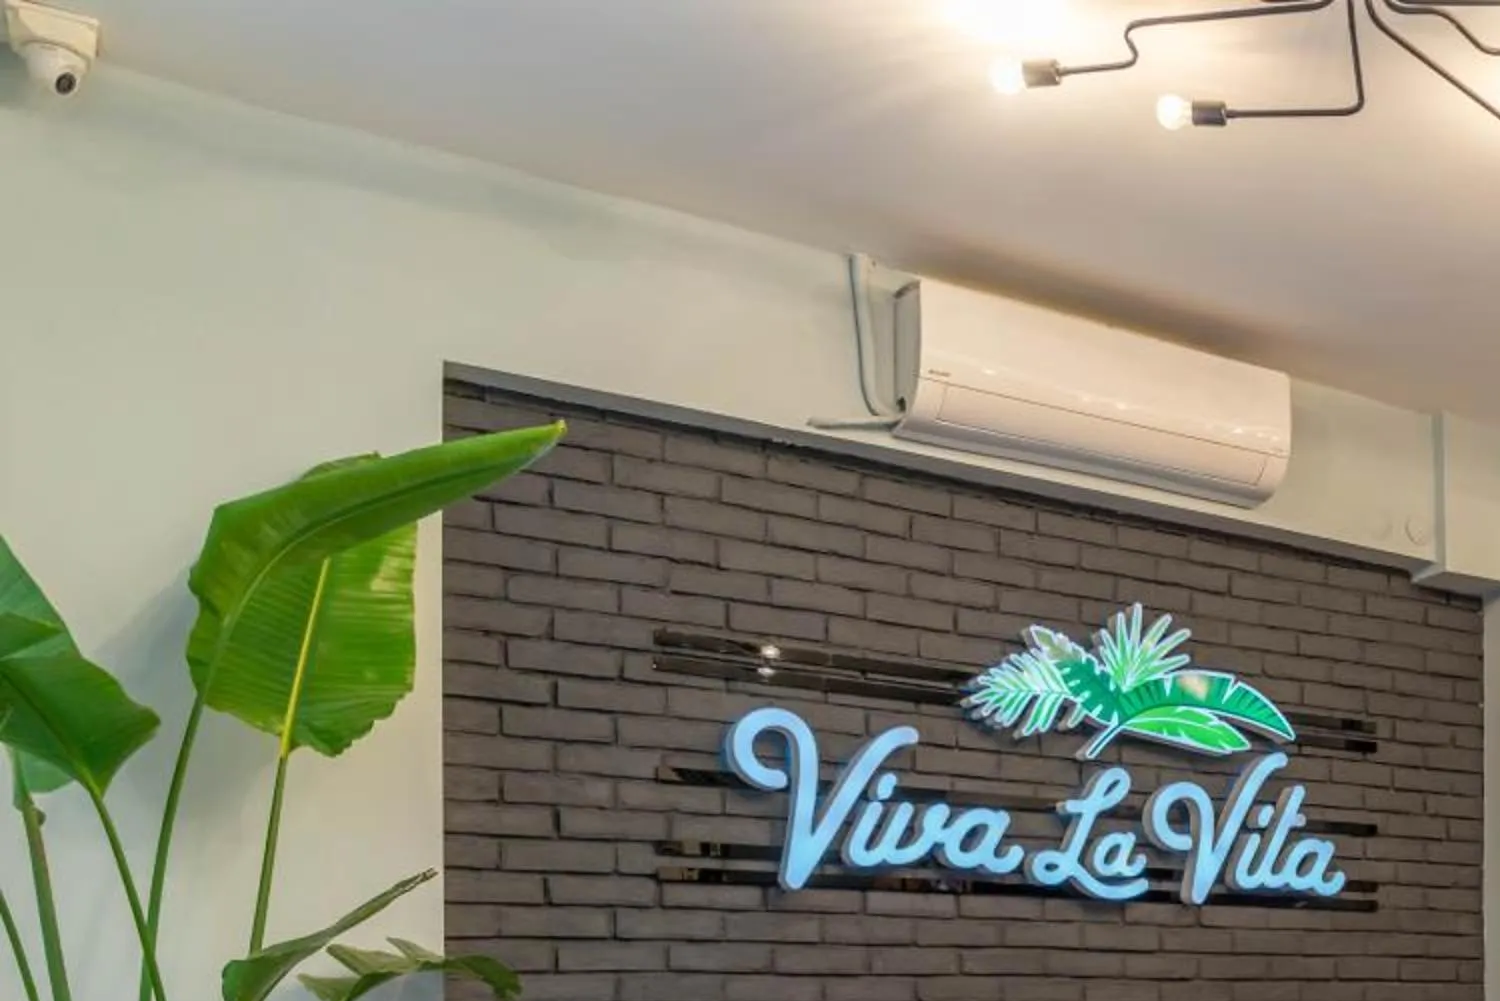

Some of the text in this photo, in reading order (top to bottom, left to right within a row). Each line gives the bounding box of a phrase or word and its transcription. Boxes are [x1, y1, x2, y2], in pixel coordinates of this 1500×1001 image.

[730, 707, 1346, 905] Viva La Vita
